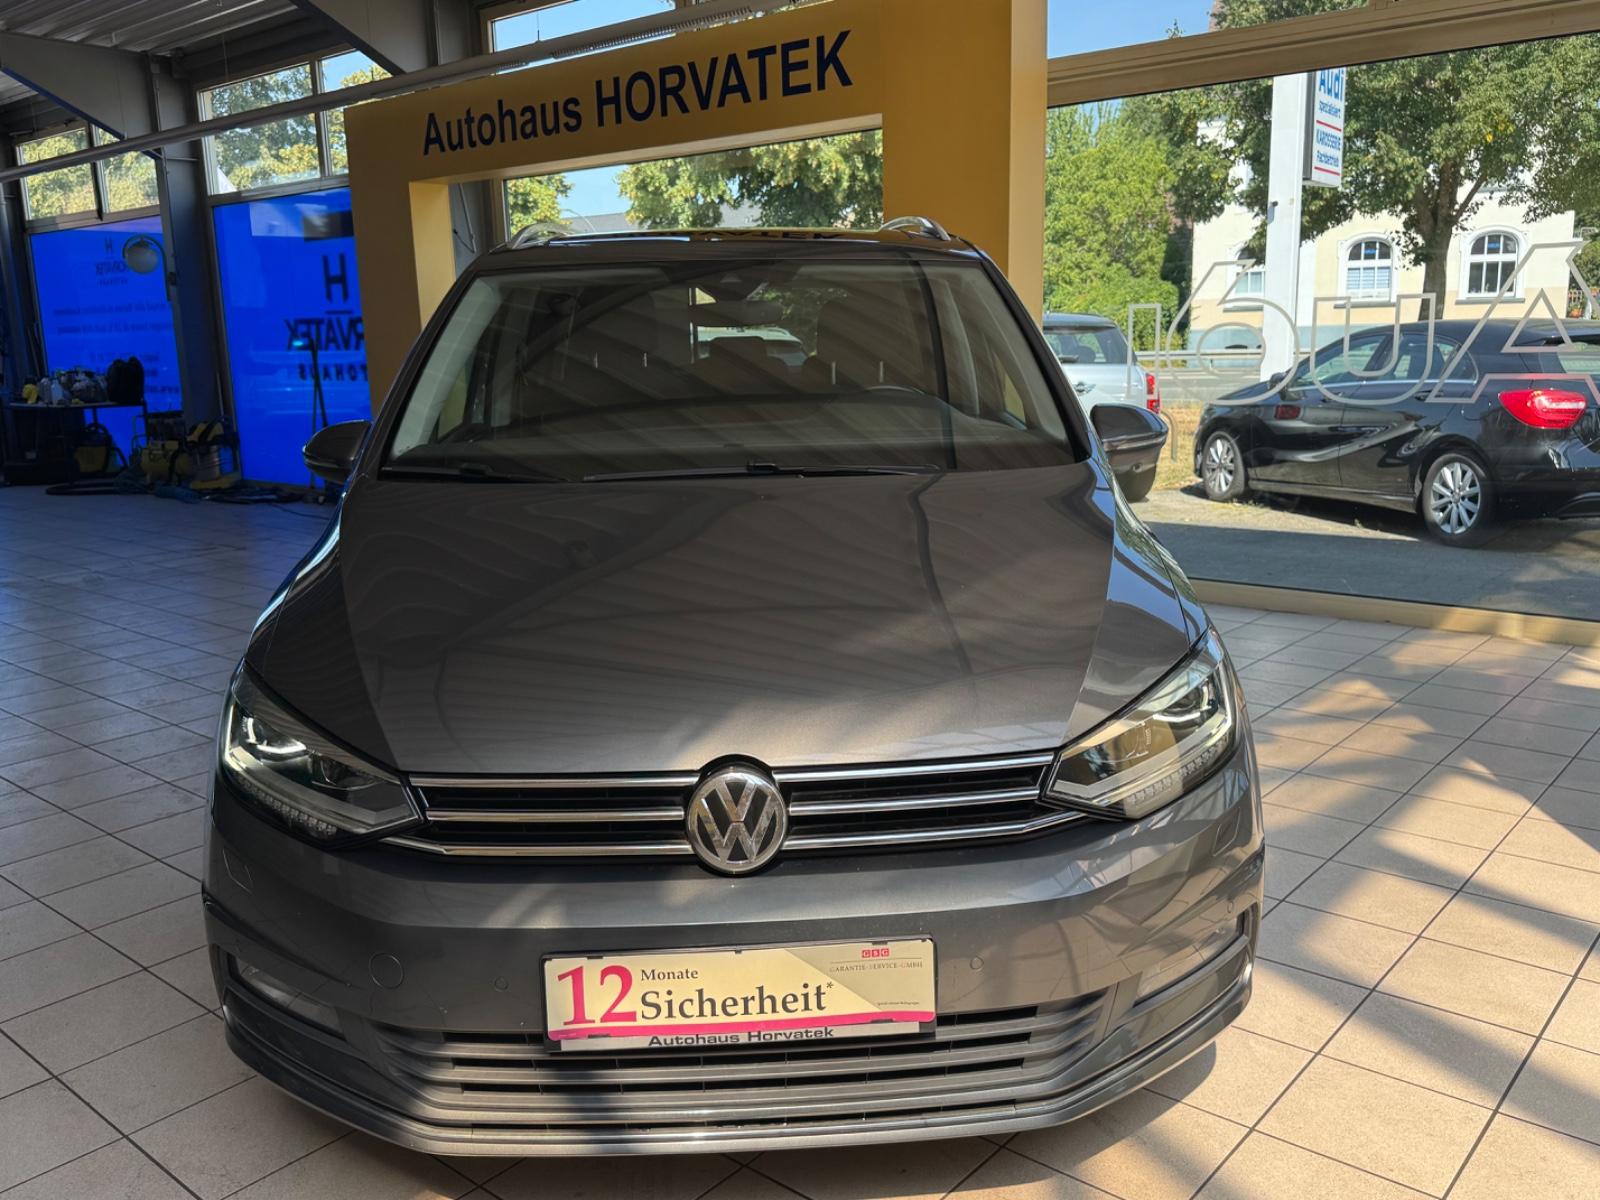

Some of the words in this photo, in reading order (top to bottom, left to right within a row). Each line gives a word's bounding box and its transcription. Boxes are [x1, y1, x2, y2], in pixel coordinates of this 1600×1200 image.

[423, 96, 583, 155] Autohaus
[595, 30, 854, 127] HORVATEK
[1318, 69, 1344, 101] Audi
[688, 766, 787, 872] VW
[557, 965, 637, 1026] 12
[641, 968, 699, 981] Monate
[648, 1034, 740, 1047] Autohaus
[748, 1026, 834, 1042] Horvatek
